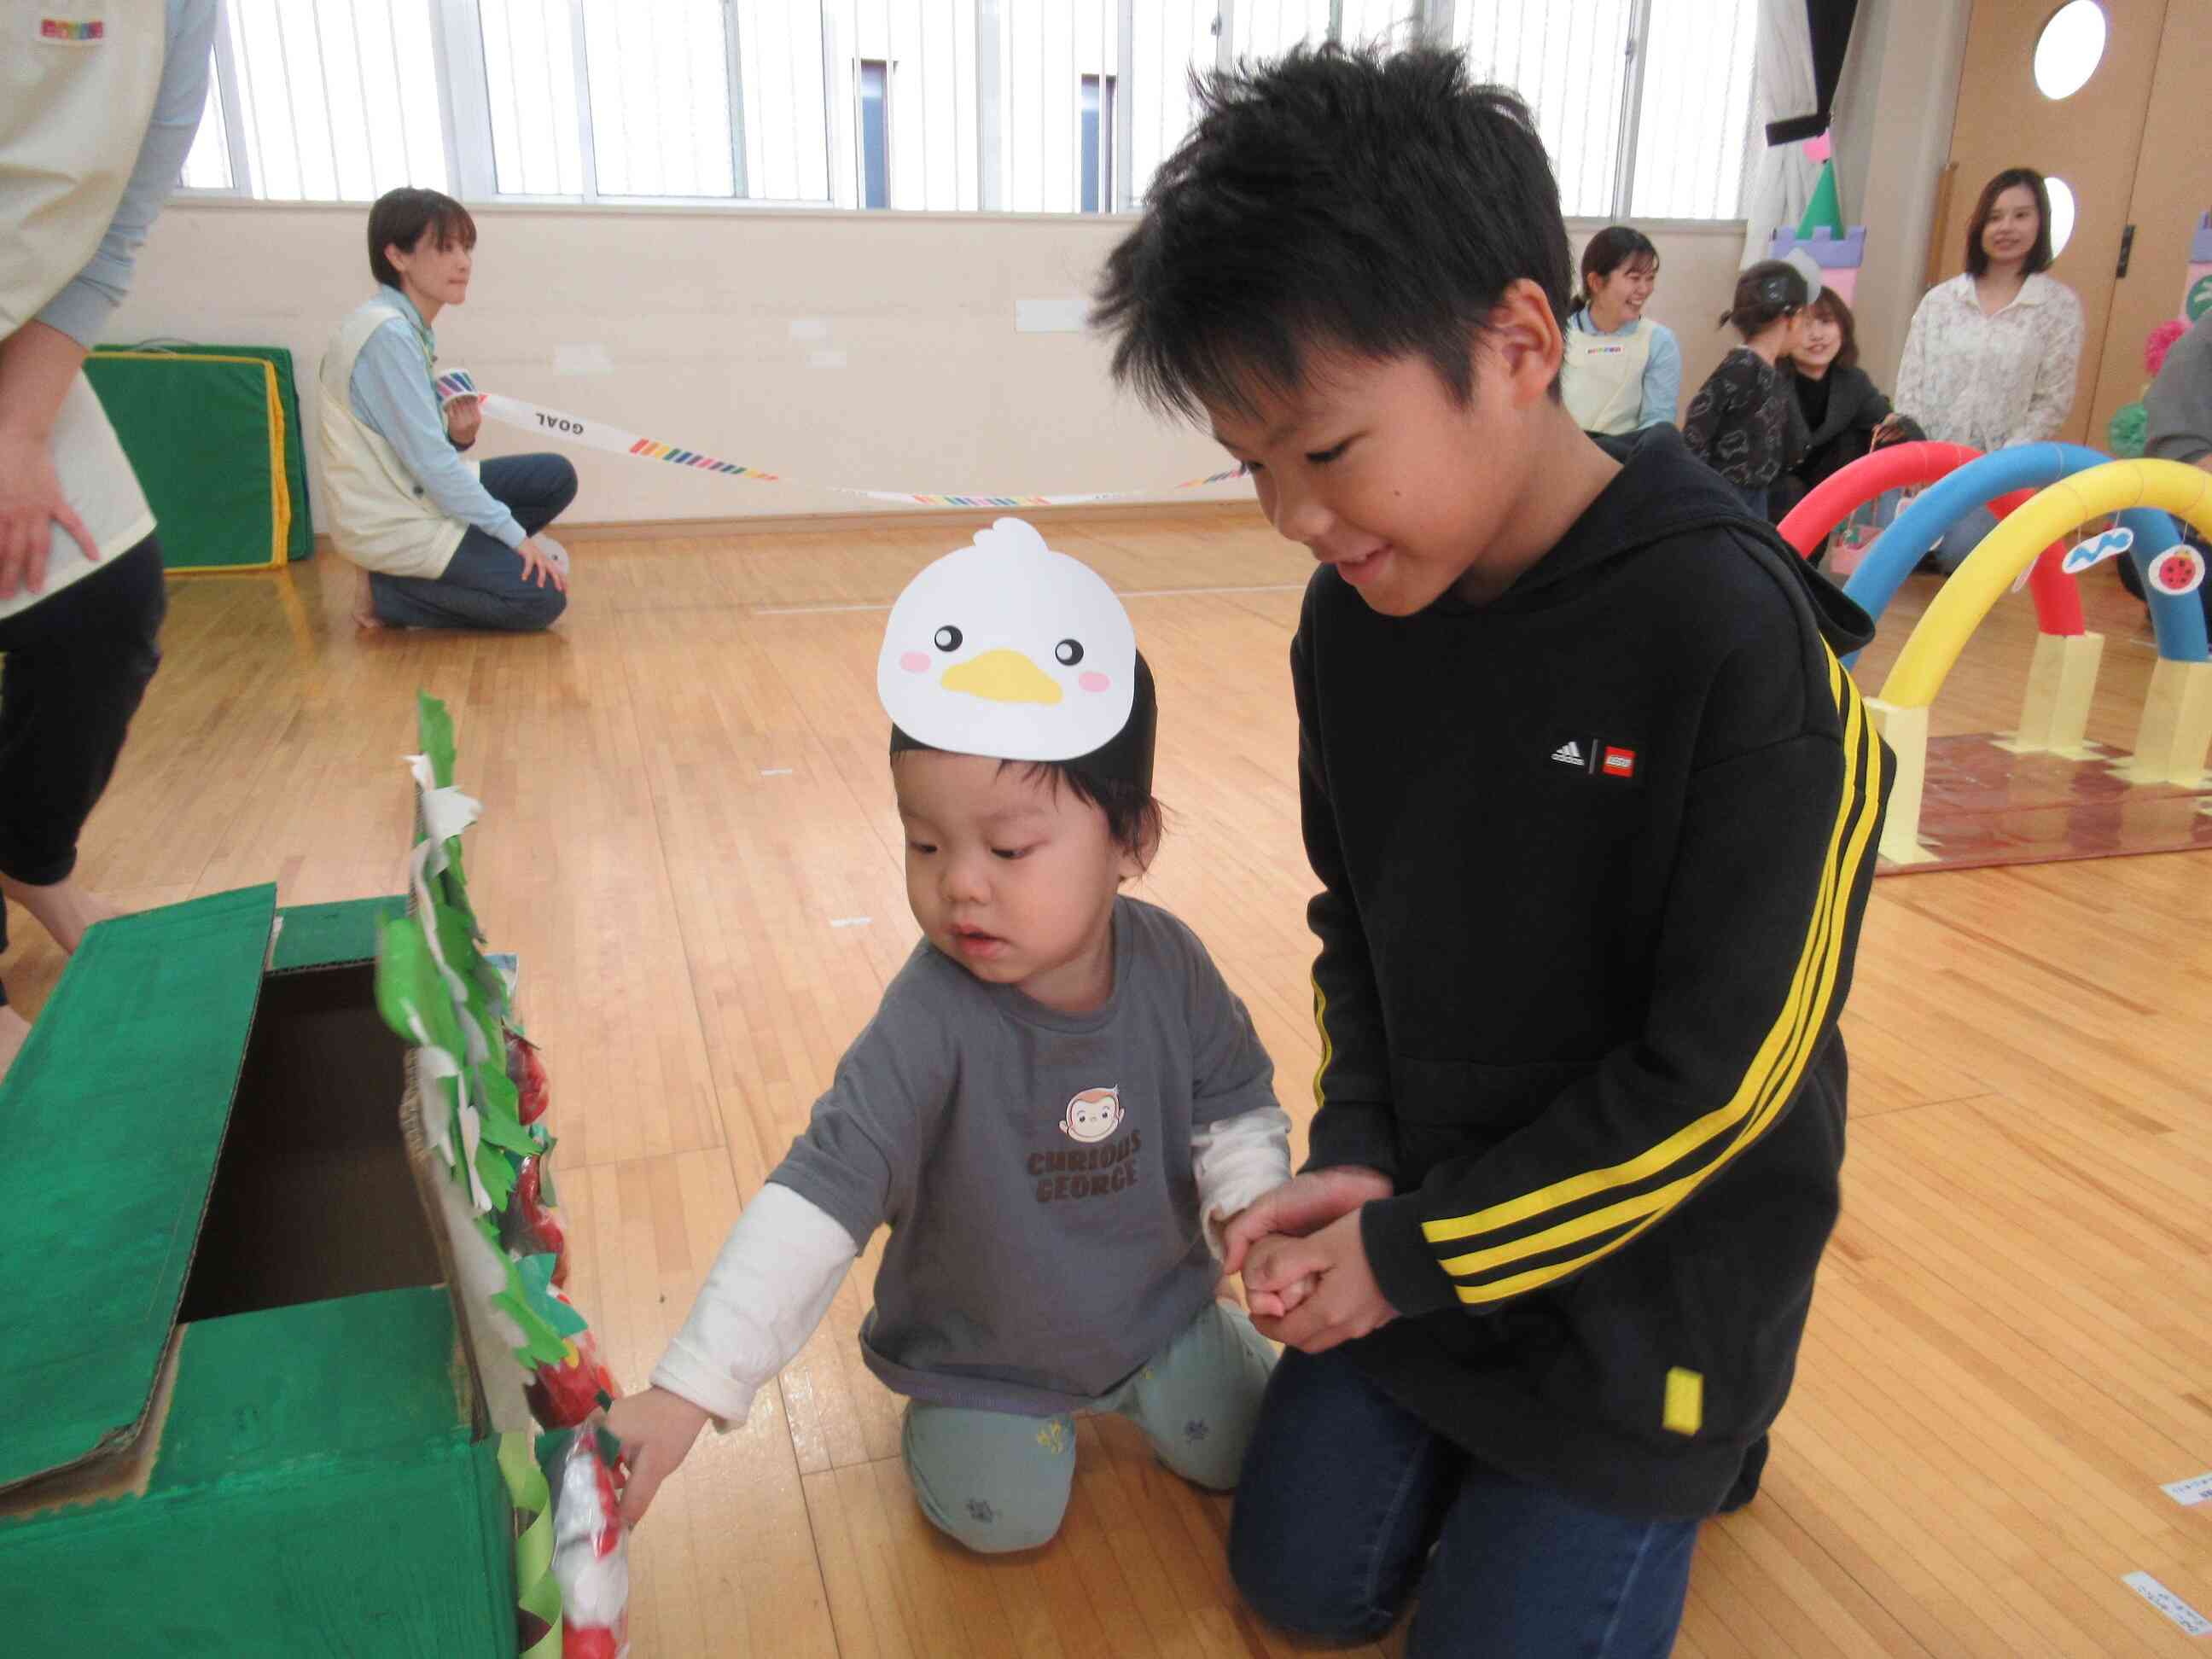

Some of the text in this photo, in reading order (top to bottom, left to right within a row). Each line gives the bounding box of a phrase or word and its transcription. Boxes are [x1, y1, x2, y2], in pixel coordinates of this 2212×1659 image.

[535, 412, 584, 434] GOAL
[1028, 1131, 1142, 1175] CURIOUS
[1036, 1160, 1138, 1202] GEORGE
